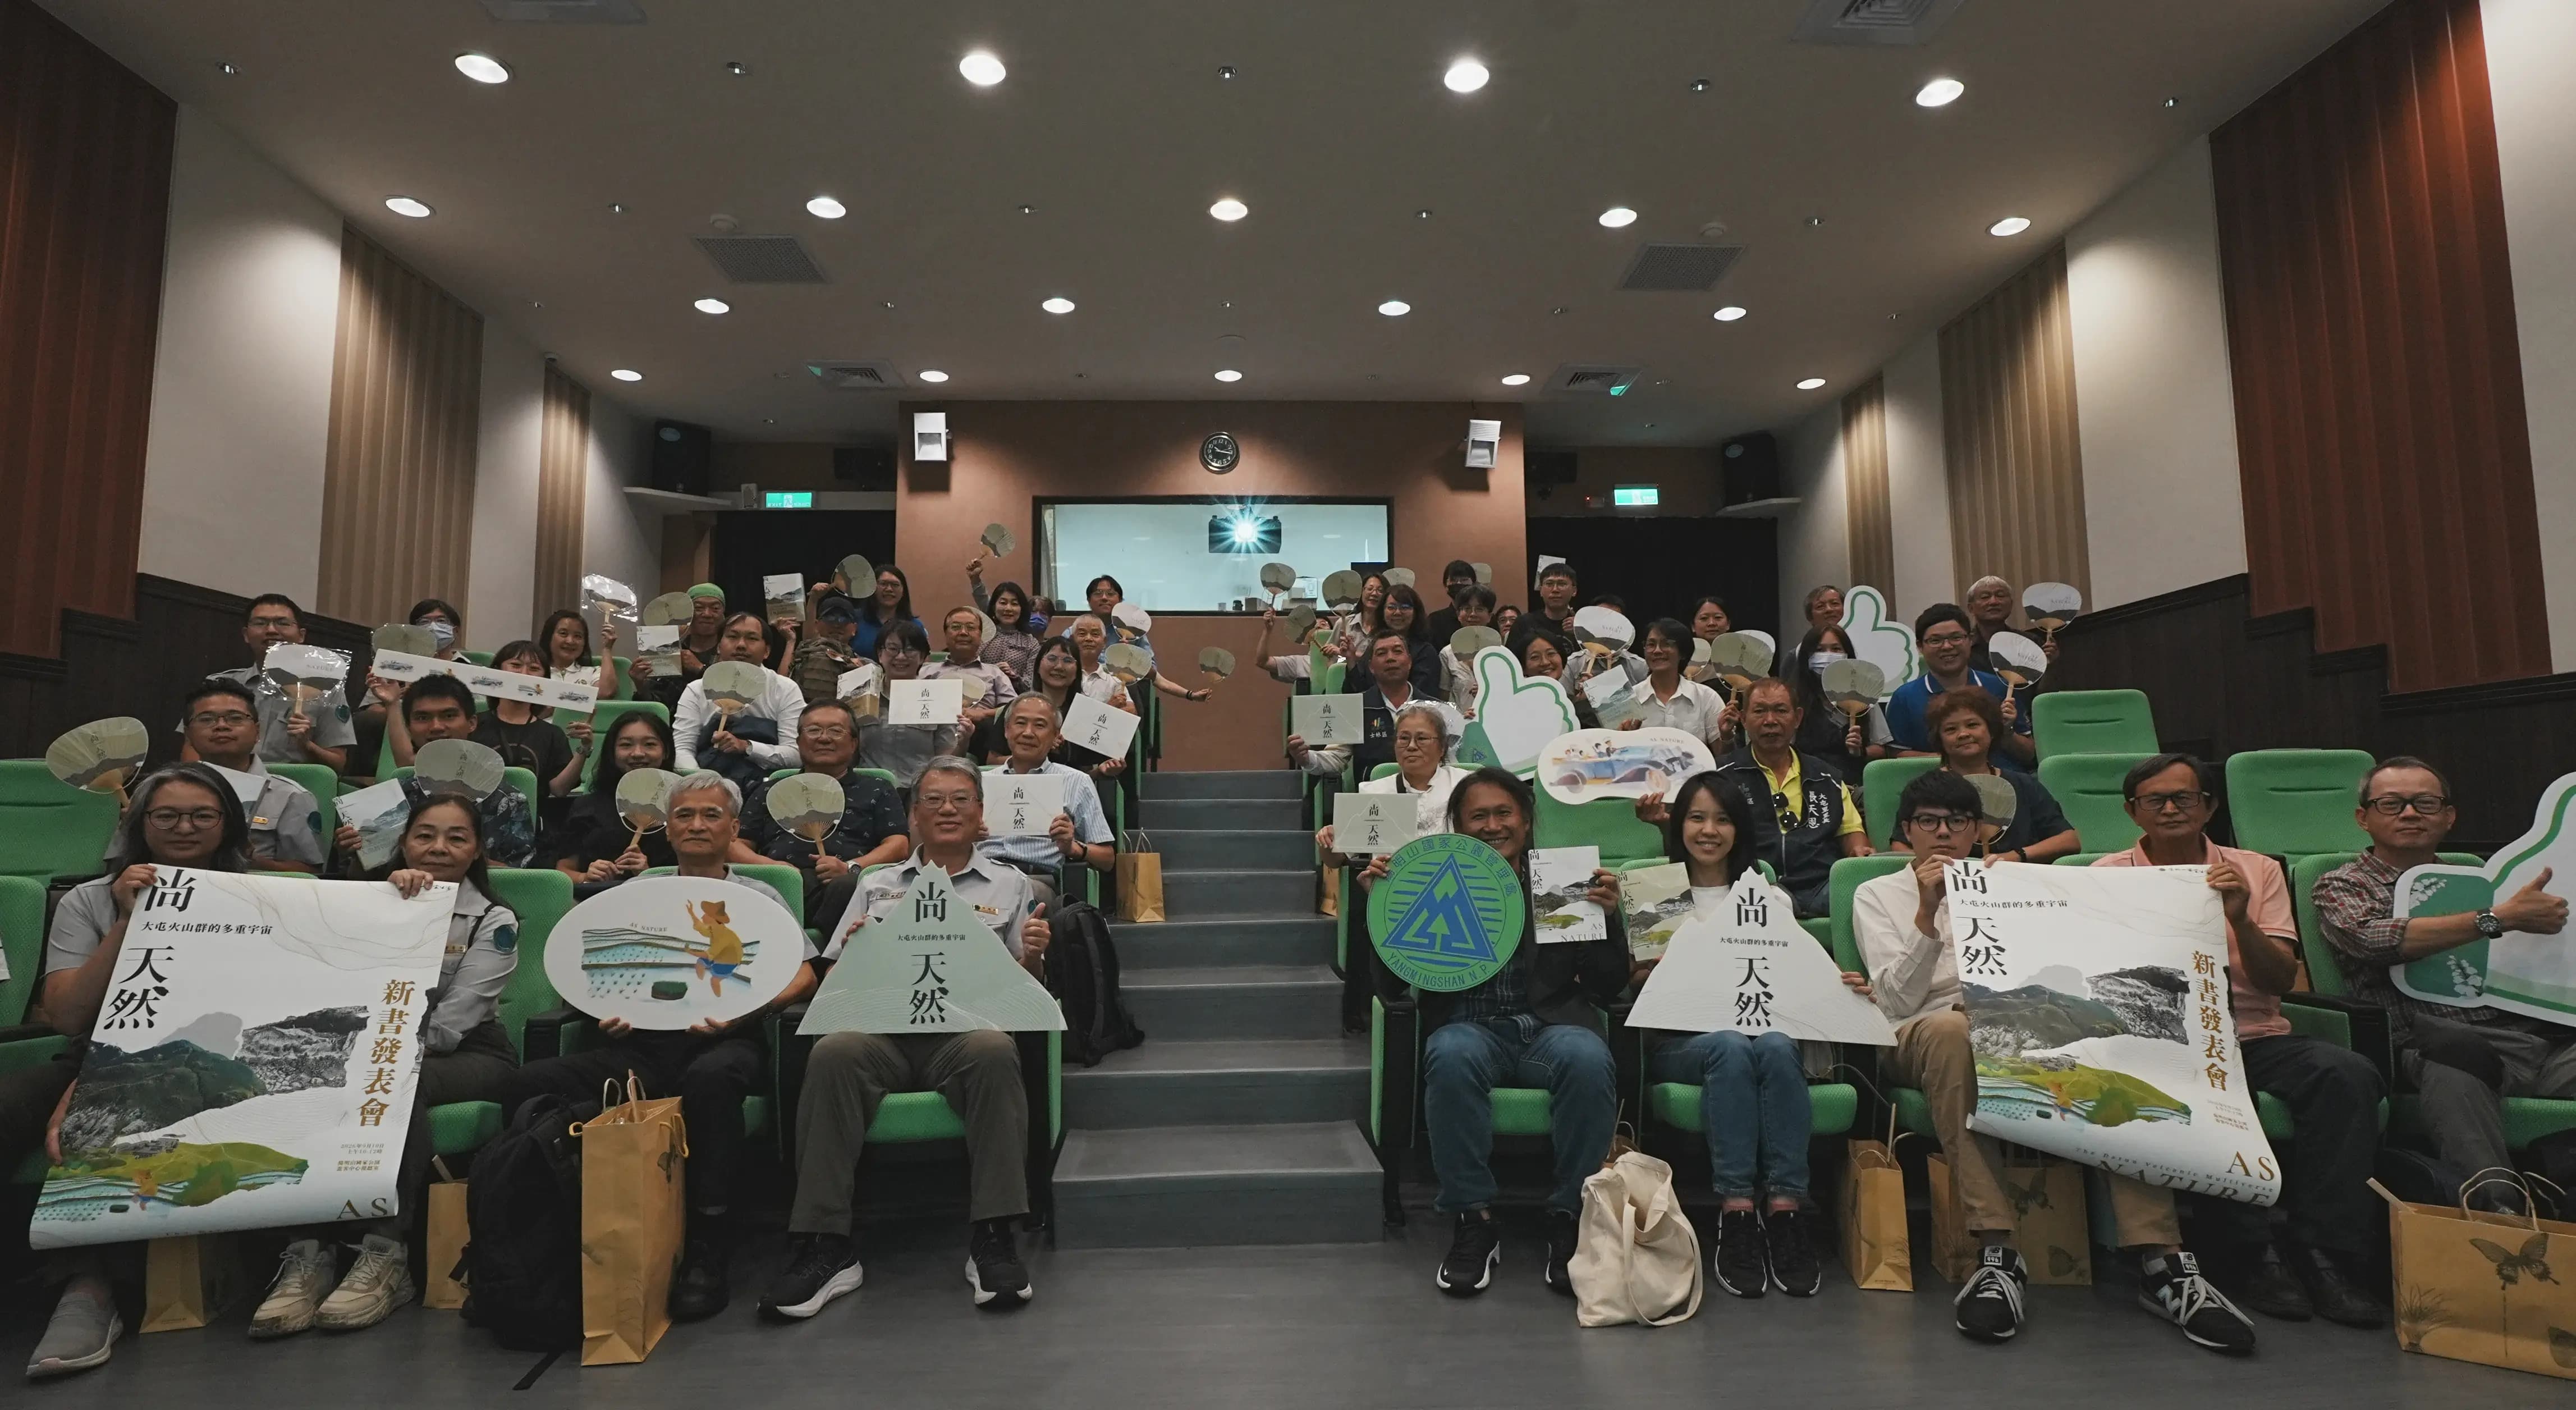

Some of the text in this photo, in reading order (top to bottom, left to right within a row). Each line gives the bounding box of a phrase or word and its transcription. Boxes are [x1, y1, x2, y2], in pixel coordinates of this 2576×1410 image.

[921, 688, 929, 698] 尚
[920, 703, 930, 719] 天然
[1098, 713, 1107, 724] 尚
[1323, 704, 1331, 714] 尚
[1089, 729, 1101, 746] 天然
[1323, 720, 1333, 739] 天然
[1014, 787, 1024, 799] 尚
[1013, 807, 1025, 829] 天然
[1369, 804, 1379, 816] 尚
[1367, 824, 1379, 845] 天然
[1530, 850, 1539, 860] 尚
[1532, 868, 1543, 890] 天然
[1618, 871, 1628, 882] 尚
[1960, 899, 2068, 909] 大屯火山群的多重宇宙
[141, 921, 273, 935] 大屯火山群的多重宇宙
[1951, 861, 2007, 976] 尚 天然
[103, 868, 197, 1030] 尚 天然
[1720, 937, 1789, 947] 大屯火山群的多重宇宙
[910, 882, 950, 1025] 尚 天然
[1734, 887, 1774, 1027] 尚 天然
[1387, 952, 1465, 987] YANGMINGSHAN
[2192, 950, 2229, 1092] 新書發表會
[358, 979, 416, 1127] 新書發表會
[2225, 1151, 2275, 1182] AS
[337, 1198, 388, 1220] AS
